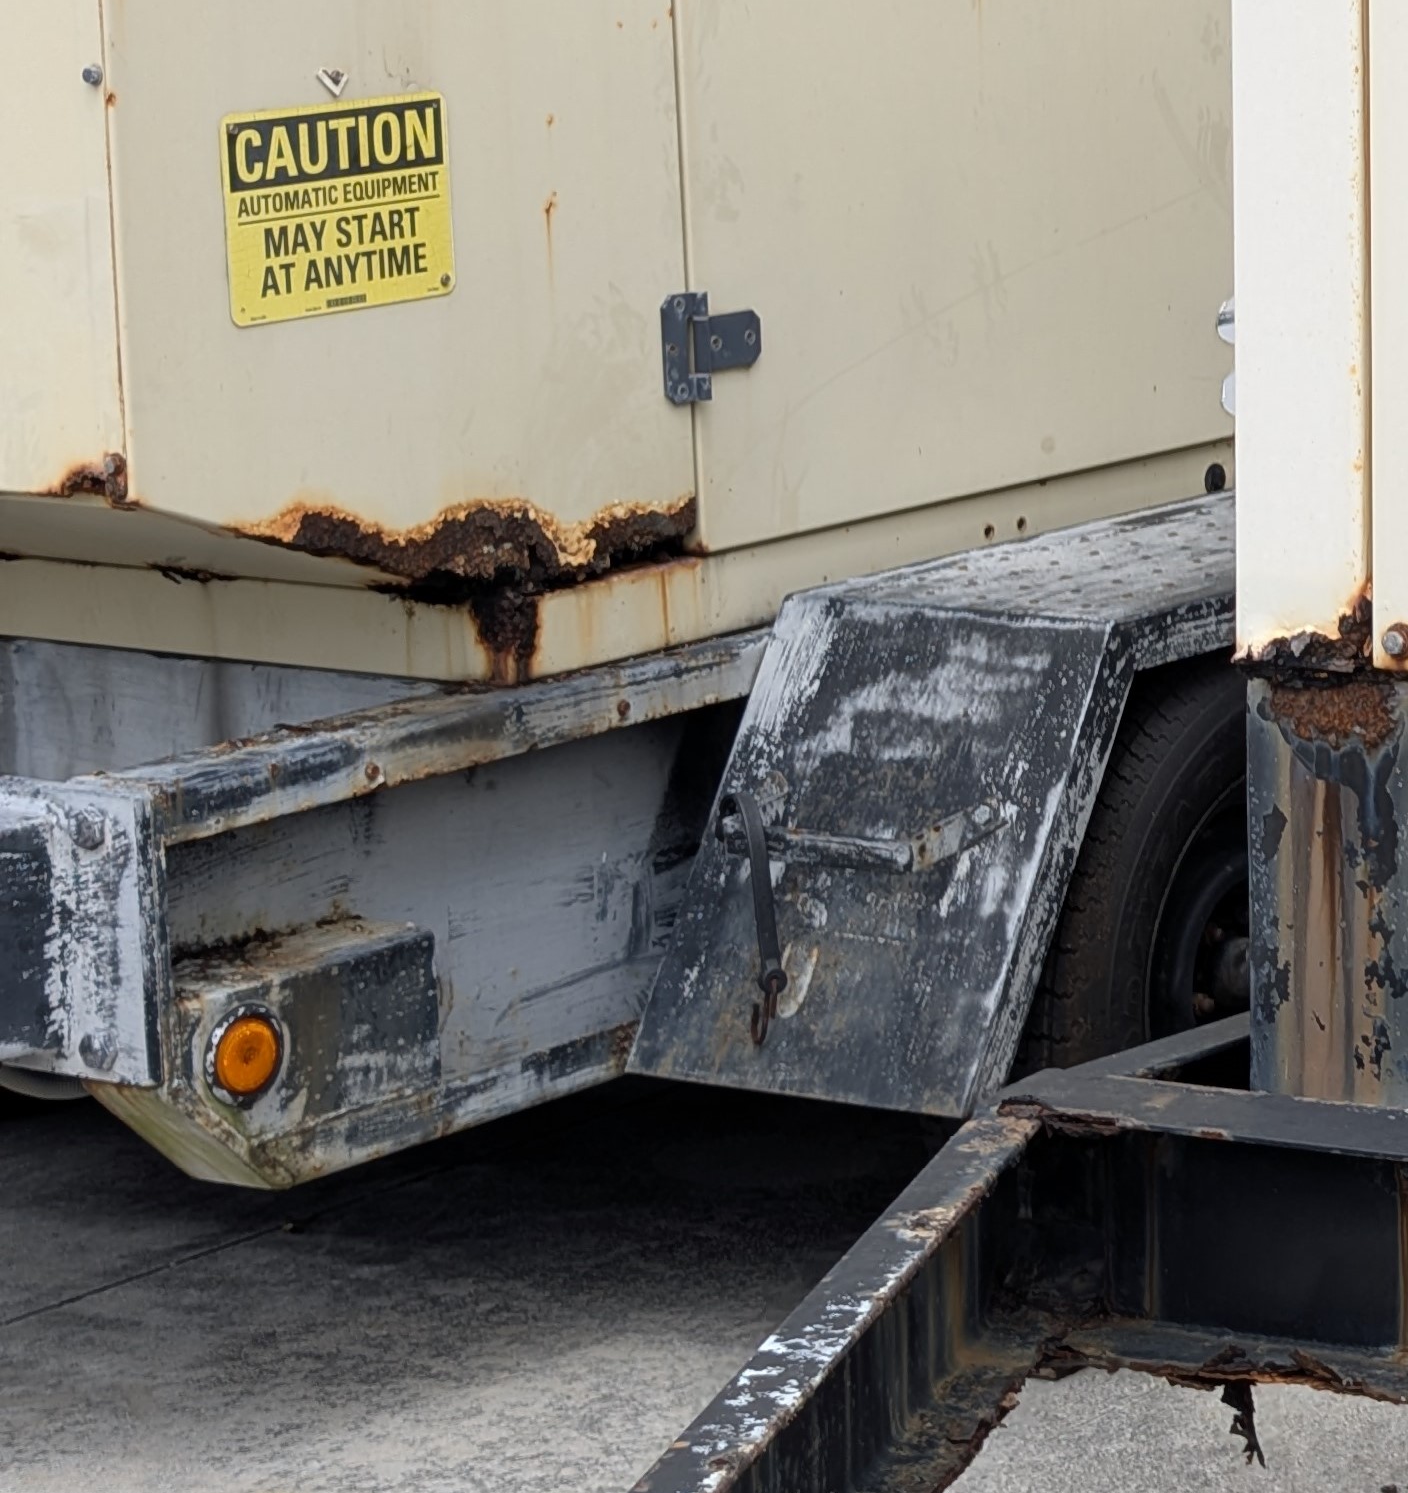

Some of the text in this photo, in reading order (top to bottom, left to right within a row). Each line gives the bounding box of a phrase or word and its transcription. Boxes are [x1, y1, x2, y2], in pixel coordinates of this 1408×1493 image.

[235, 107, 436, 184] CAUTION
[238, 171, 439, 219] AUTOMATIC EQUIPMENT
[263, 206, 420, 259] MAY START
[261, 242, 428, 298] AT ANYTIME
